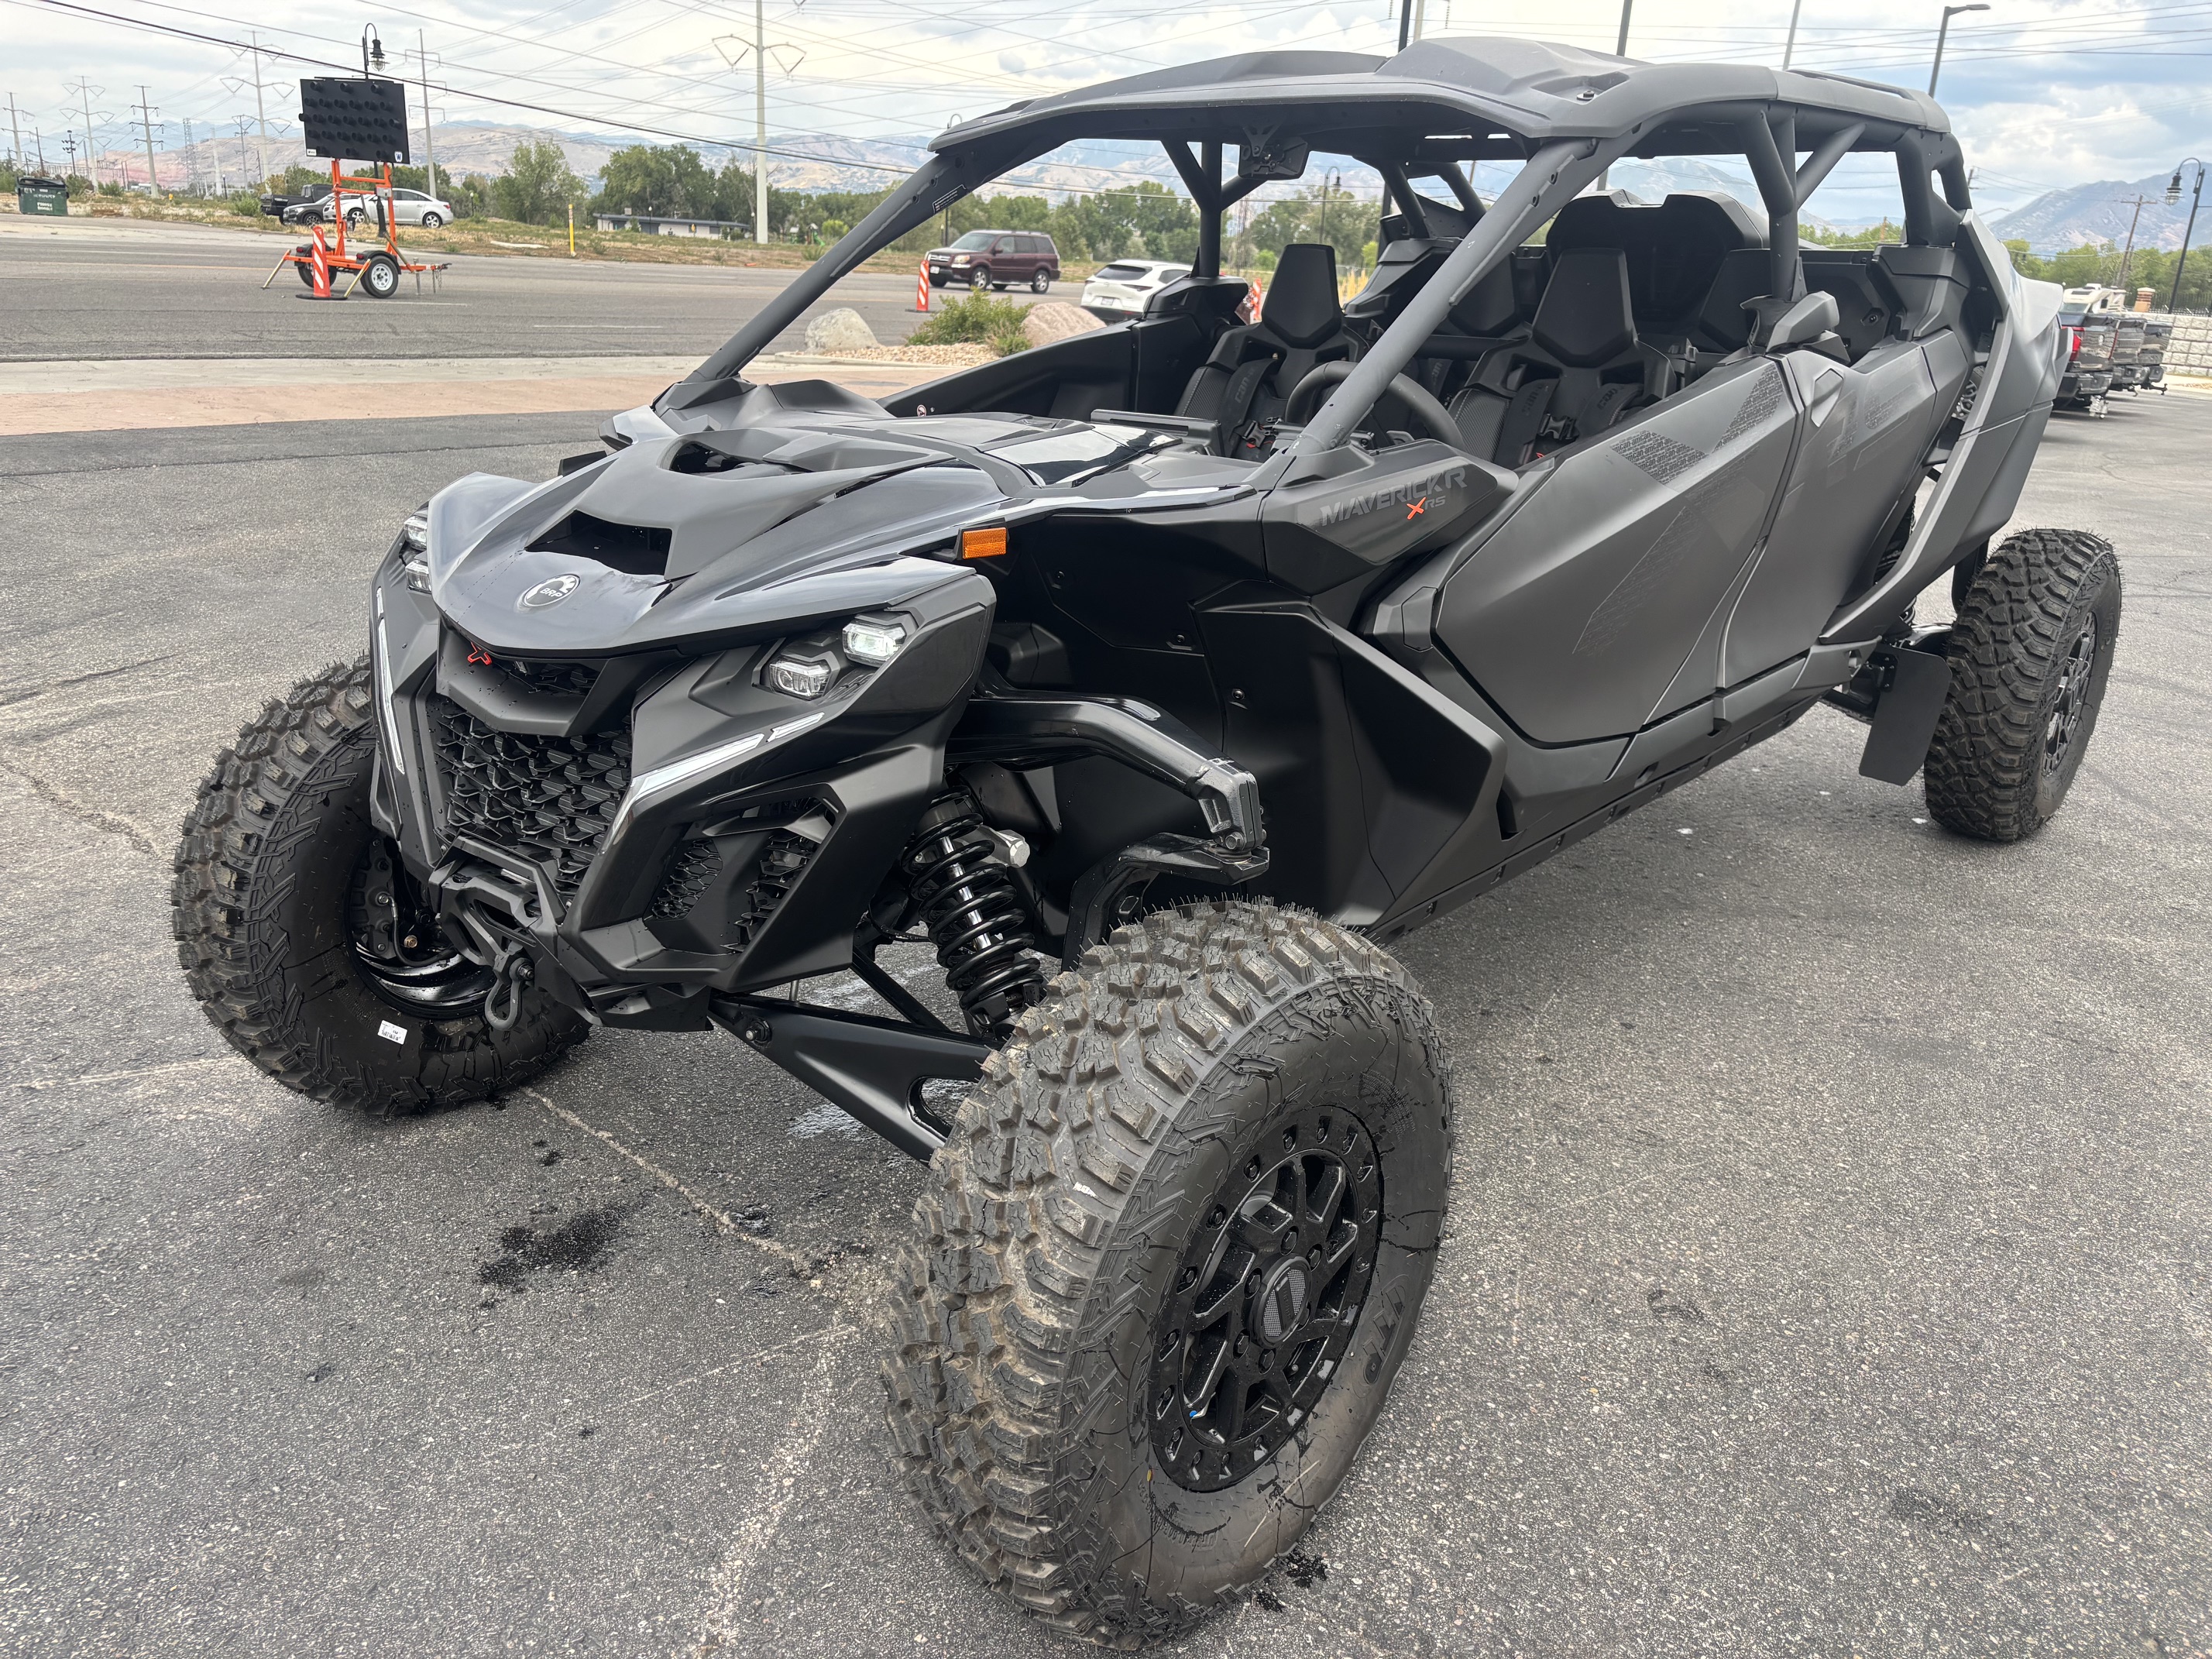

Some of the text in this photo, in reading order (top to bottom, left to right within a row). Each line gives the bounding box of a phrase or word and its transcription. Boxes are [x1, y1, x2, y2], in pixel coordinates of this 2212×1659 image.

[1319, 466, 1468, 527] MAVERICK R
[539, 587, 563, 597] BRP
